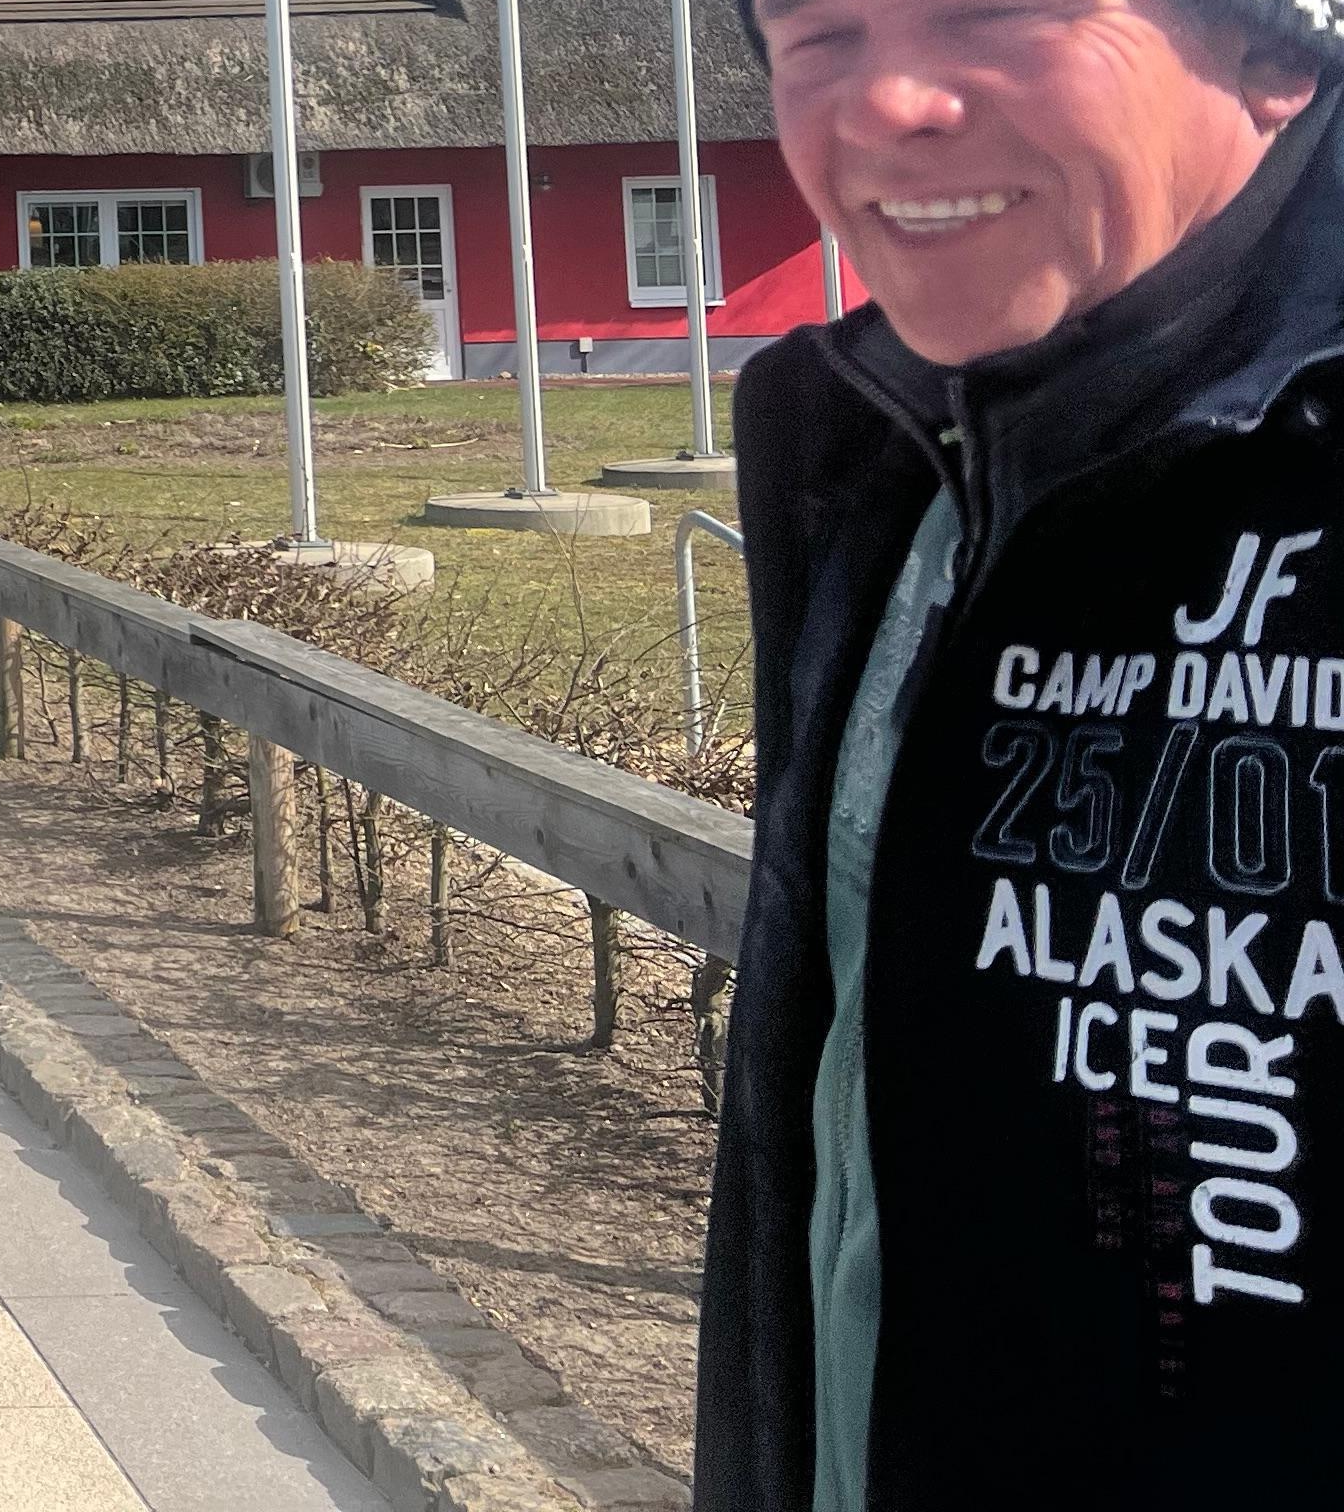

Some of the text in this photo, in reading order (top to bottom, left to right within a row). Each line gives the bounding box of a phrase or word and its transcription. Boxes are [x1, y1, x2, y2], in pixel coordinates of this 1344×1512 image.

[1173, 528, 1323, 647] JF
[992, 644, 1344, 732] CAMP DAVID
[976, 878, 1344, 1026] ALASKA
[1051, 996, 1180, 1104] ICE
[1186, 1020, 1305, 1306] TOUR
